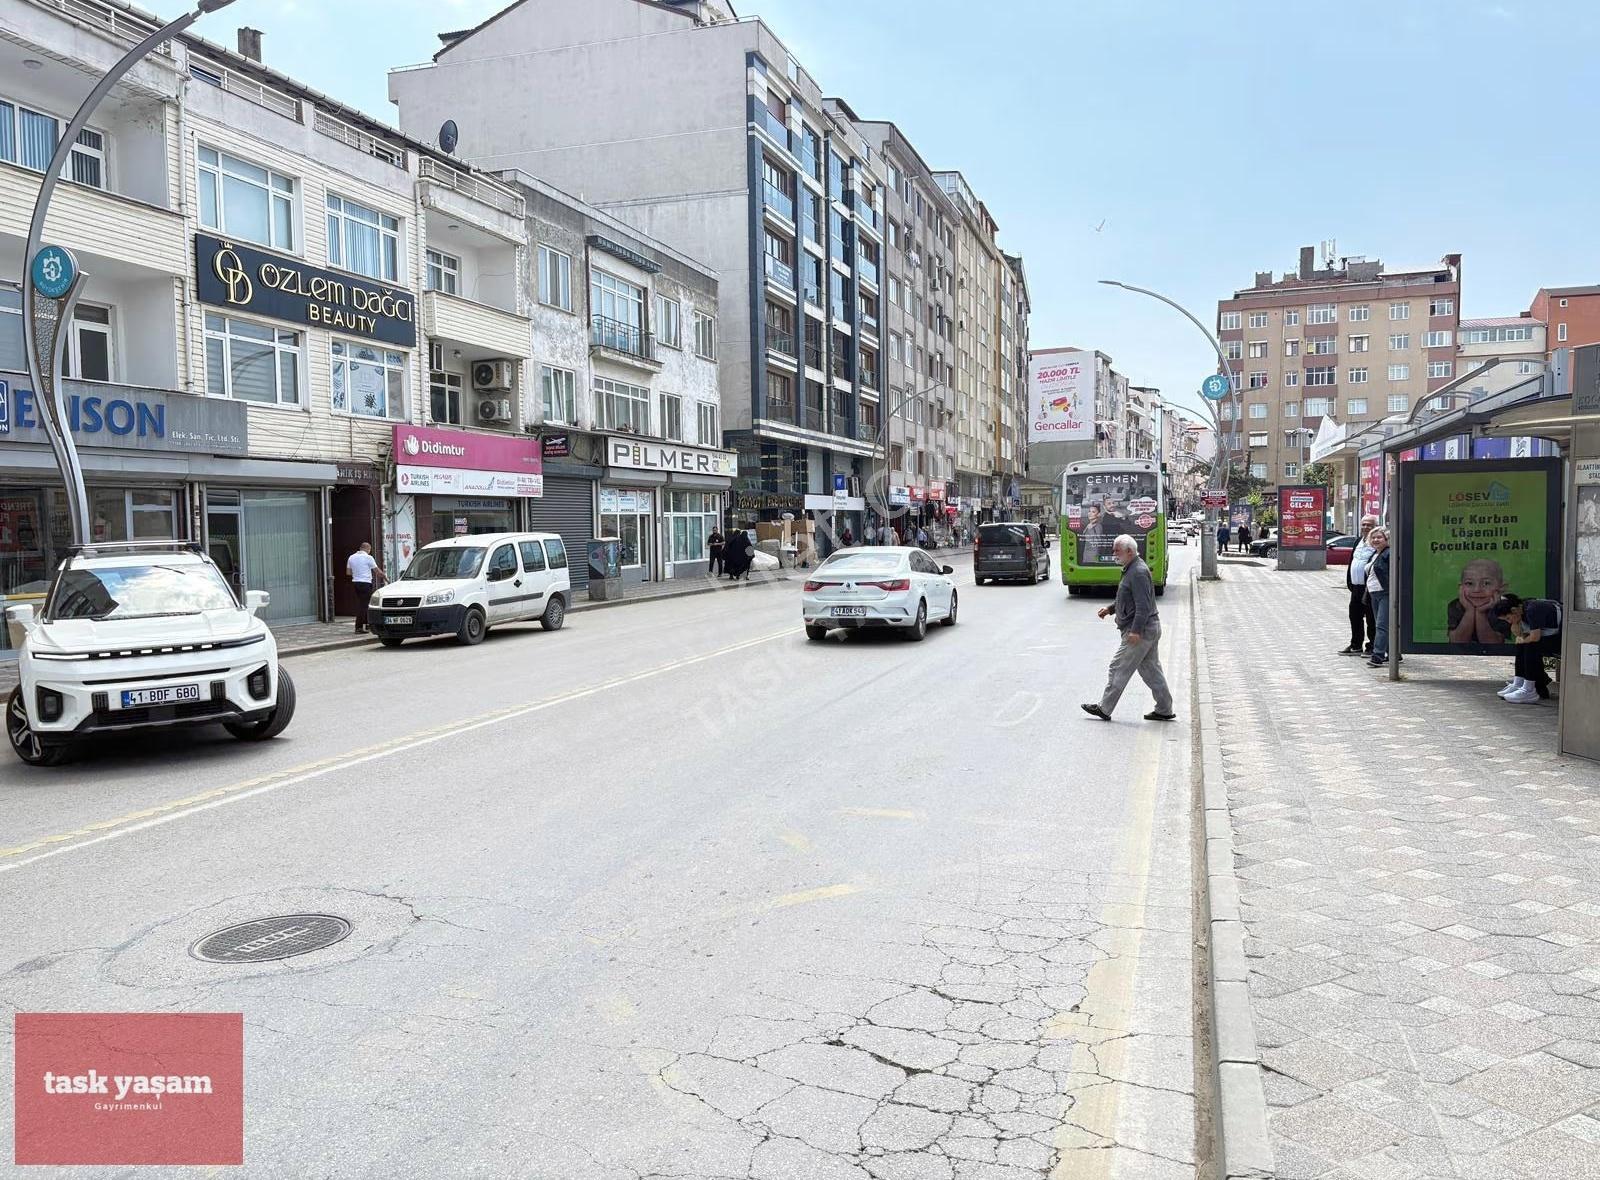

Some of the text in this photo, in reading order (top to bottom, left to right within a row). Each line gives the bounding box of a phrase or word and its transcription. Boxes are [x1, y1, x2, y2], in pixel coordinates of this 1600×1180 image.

[308, 303, 377, 334] BEAUTY
[1037, 368, 1068, 379] 20.000
[1070, 366, 1080, 374] TL
[14, 389, 165, 438] EISON
[1034, 420, 1083, 431] Gencallar
[421, 440, 465, 456] Didimtur
[1441, 514, 1518, 525] Her Kurban
[1430, 540, 1529, 554] Çocuklara CAN
[130, 687, 197, 703] 41 BDF 680
